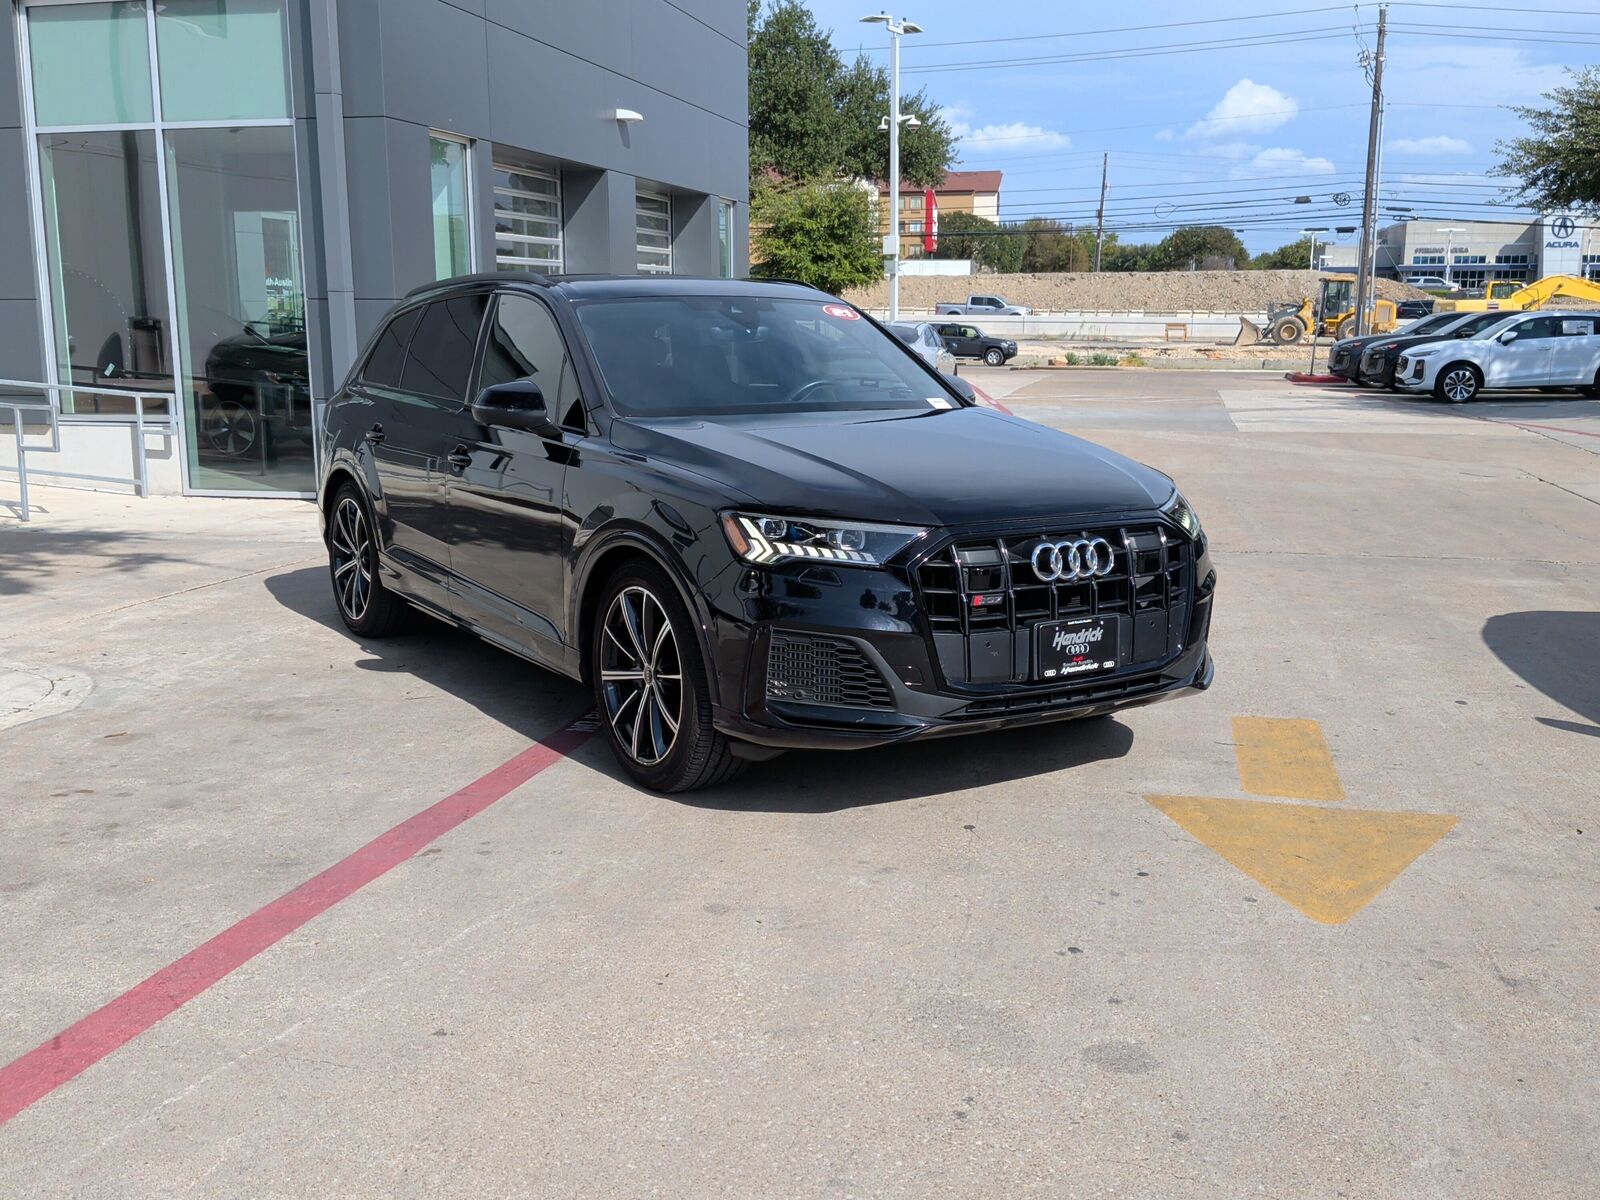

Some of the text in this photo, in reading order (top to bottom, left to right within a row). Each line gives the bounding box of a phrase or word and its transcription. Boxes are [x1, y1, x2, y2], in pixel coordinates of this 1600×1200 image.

[1544, 241, 1580, 249] ACURA
[1052, 626, 1104, 652] Hendrick
[1060, 662, 1100, 676] Hendrick
